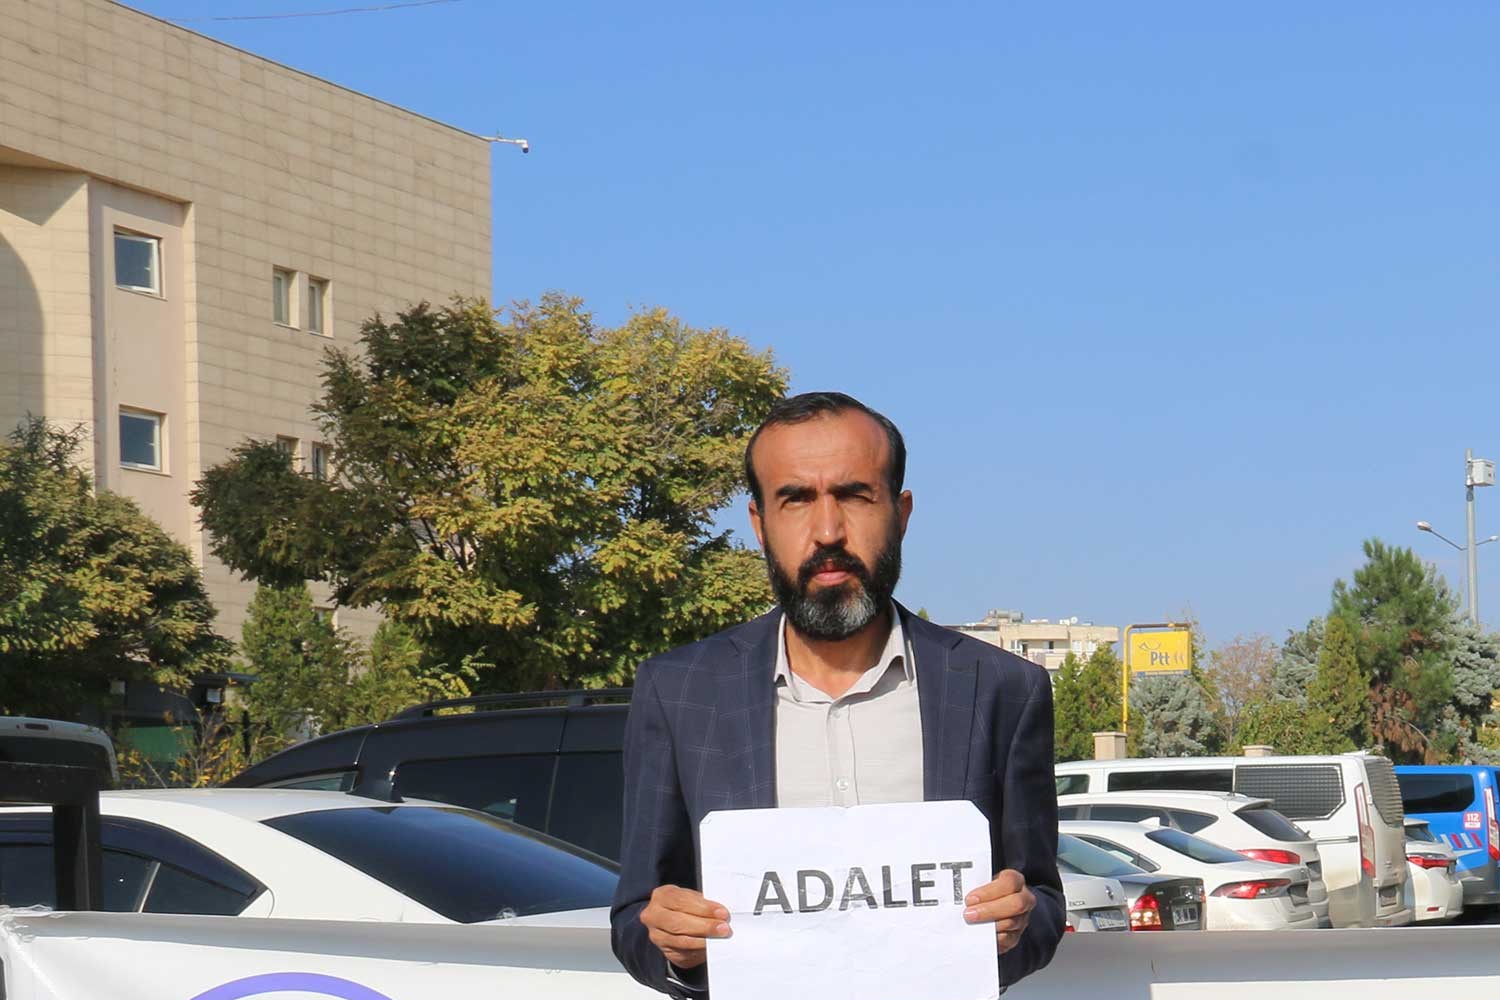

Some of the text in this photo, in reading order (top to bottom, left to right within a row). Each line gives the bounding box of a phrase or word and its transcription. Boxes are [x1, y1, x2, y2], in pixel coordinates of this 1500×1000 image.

[1150, 651, 1170, 665] Ptt
[1466, 812, 1480, 822] 112
[753, 860, 974, 916] ADALET
